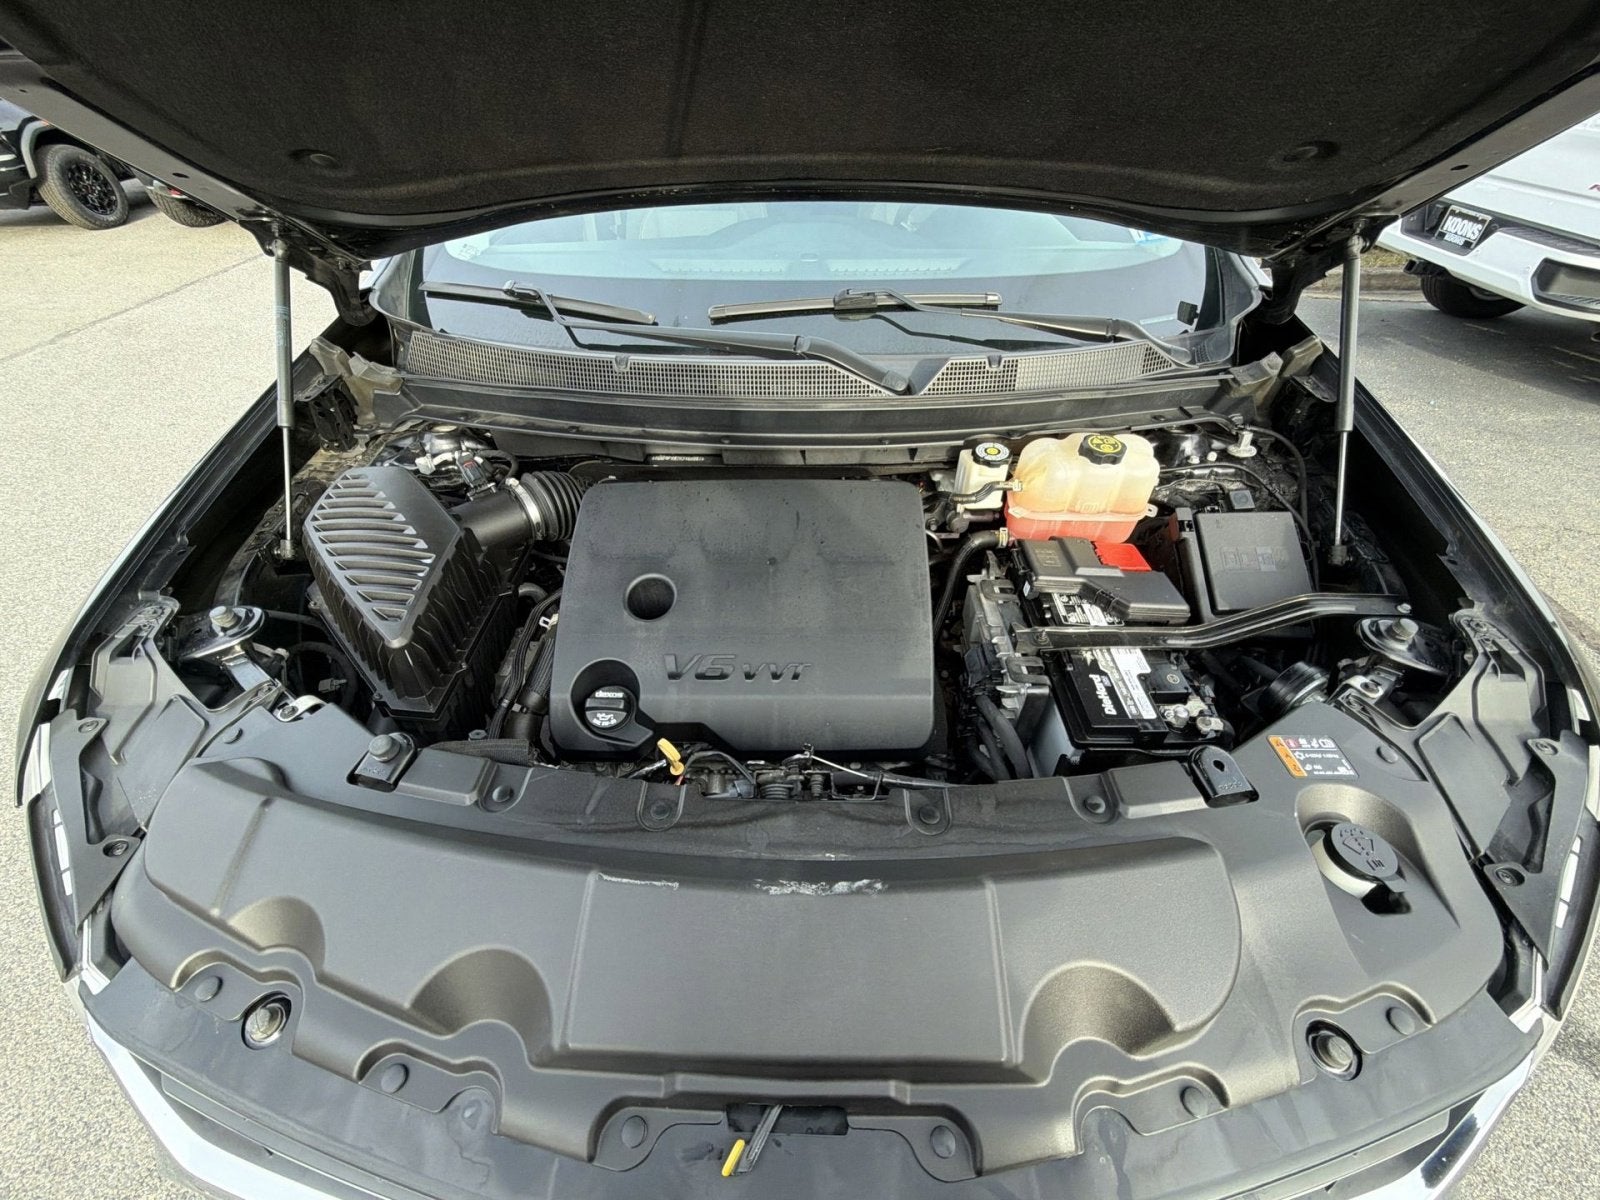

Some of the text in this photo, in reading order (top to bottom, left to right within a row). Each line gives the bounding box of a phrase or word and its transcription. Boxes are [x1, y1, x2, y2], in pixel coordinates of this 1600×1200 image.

[1443, 215, 1483, 240] KOONS
[663, 653, 812, 682] V6 VVT
[1088, 673, 1118, 716] DieHard
